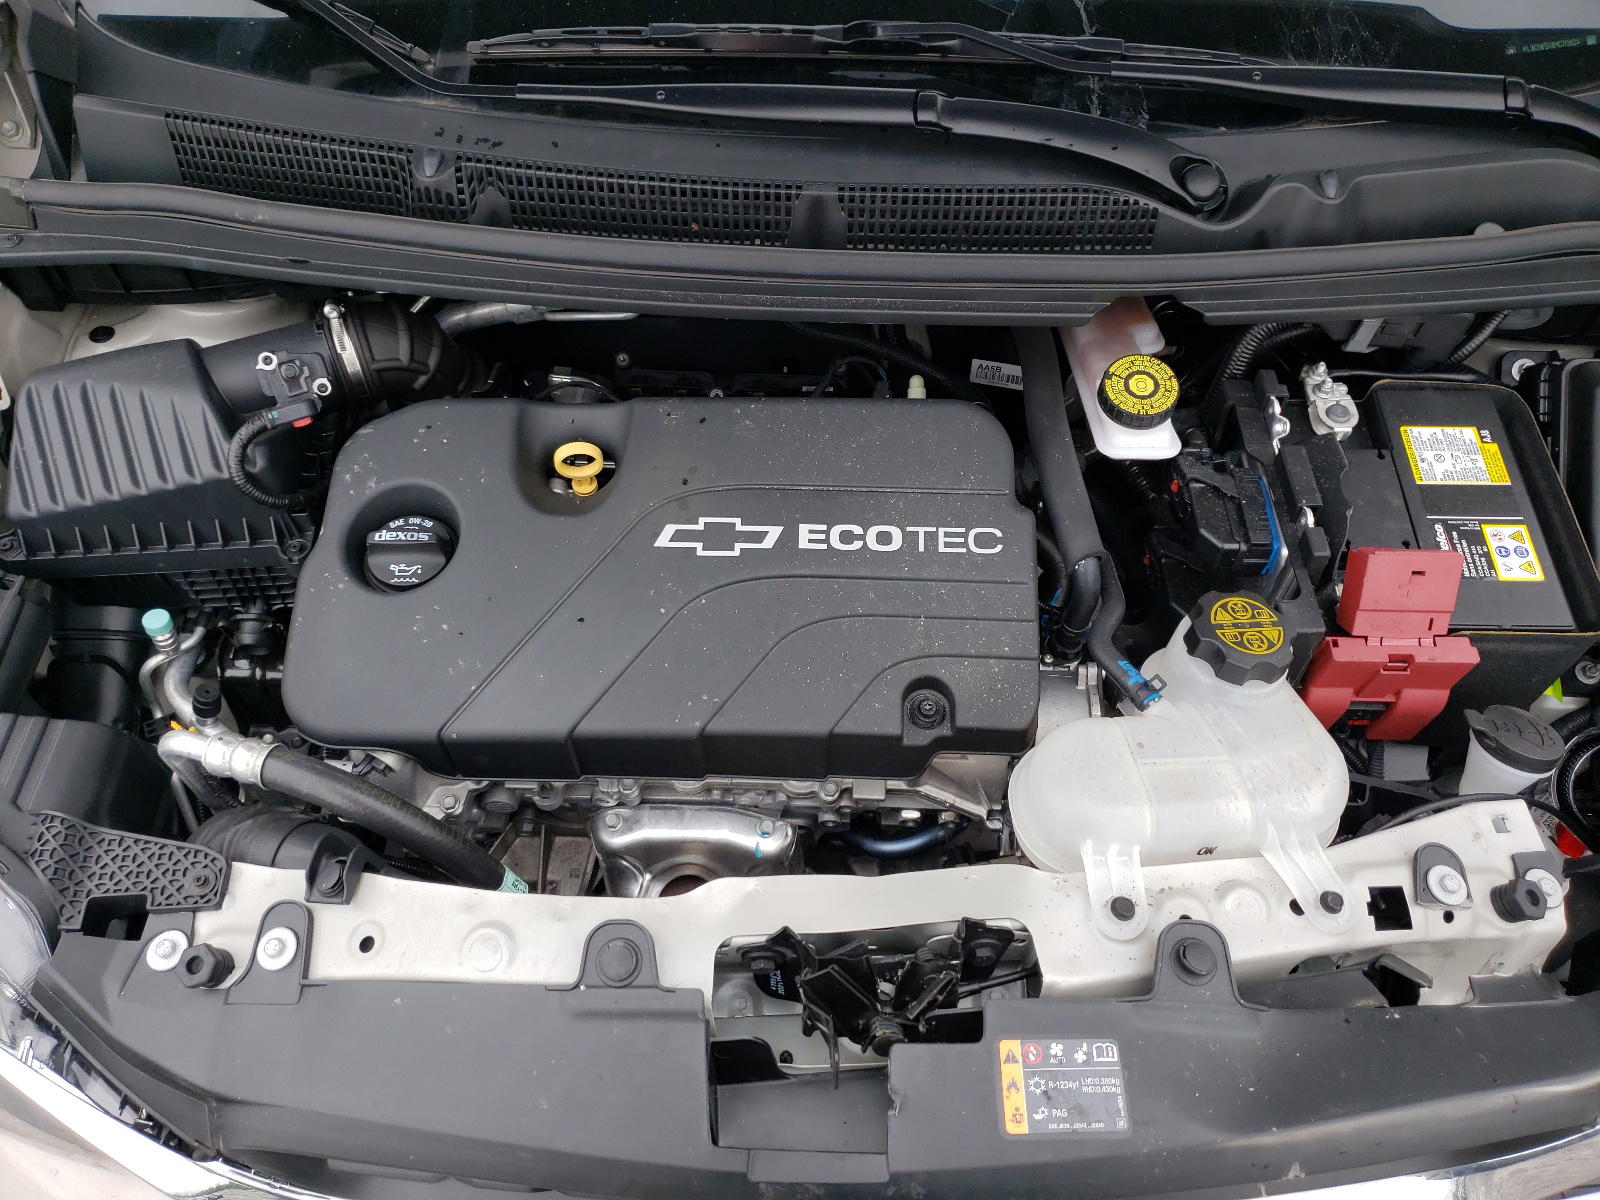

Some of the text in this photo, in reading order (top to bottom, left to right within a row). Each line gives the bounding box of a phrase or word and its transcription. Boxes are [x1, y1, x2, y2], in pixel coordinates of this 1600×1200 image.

[389, 517, 434, 529] SAE 0W-20
[374, 530, 433, 541] dexos
[798, 523, 1004, 554] ECOTEC
[1049, 1056, 1066, 1065] AUTO
[1048, 1080, 1080, 1090] R-1234yf
[1051, 1108, 1068, 1118] PAG
